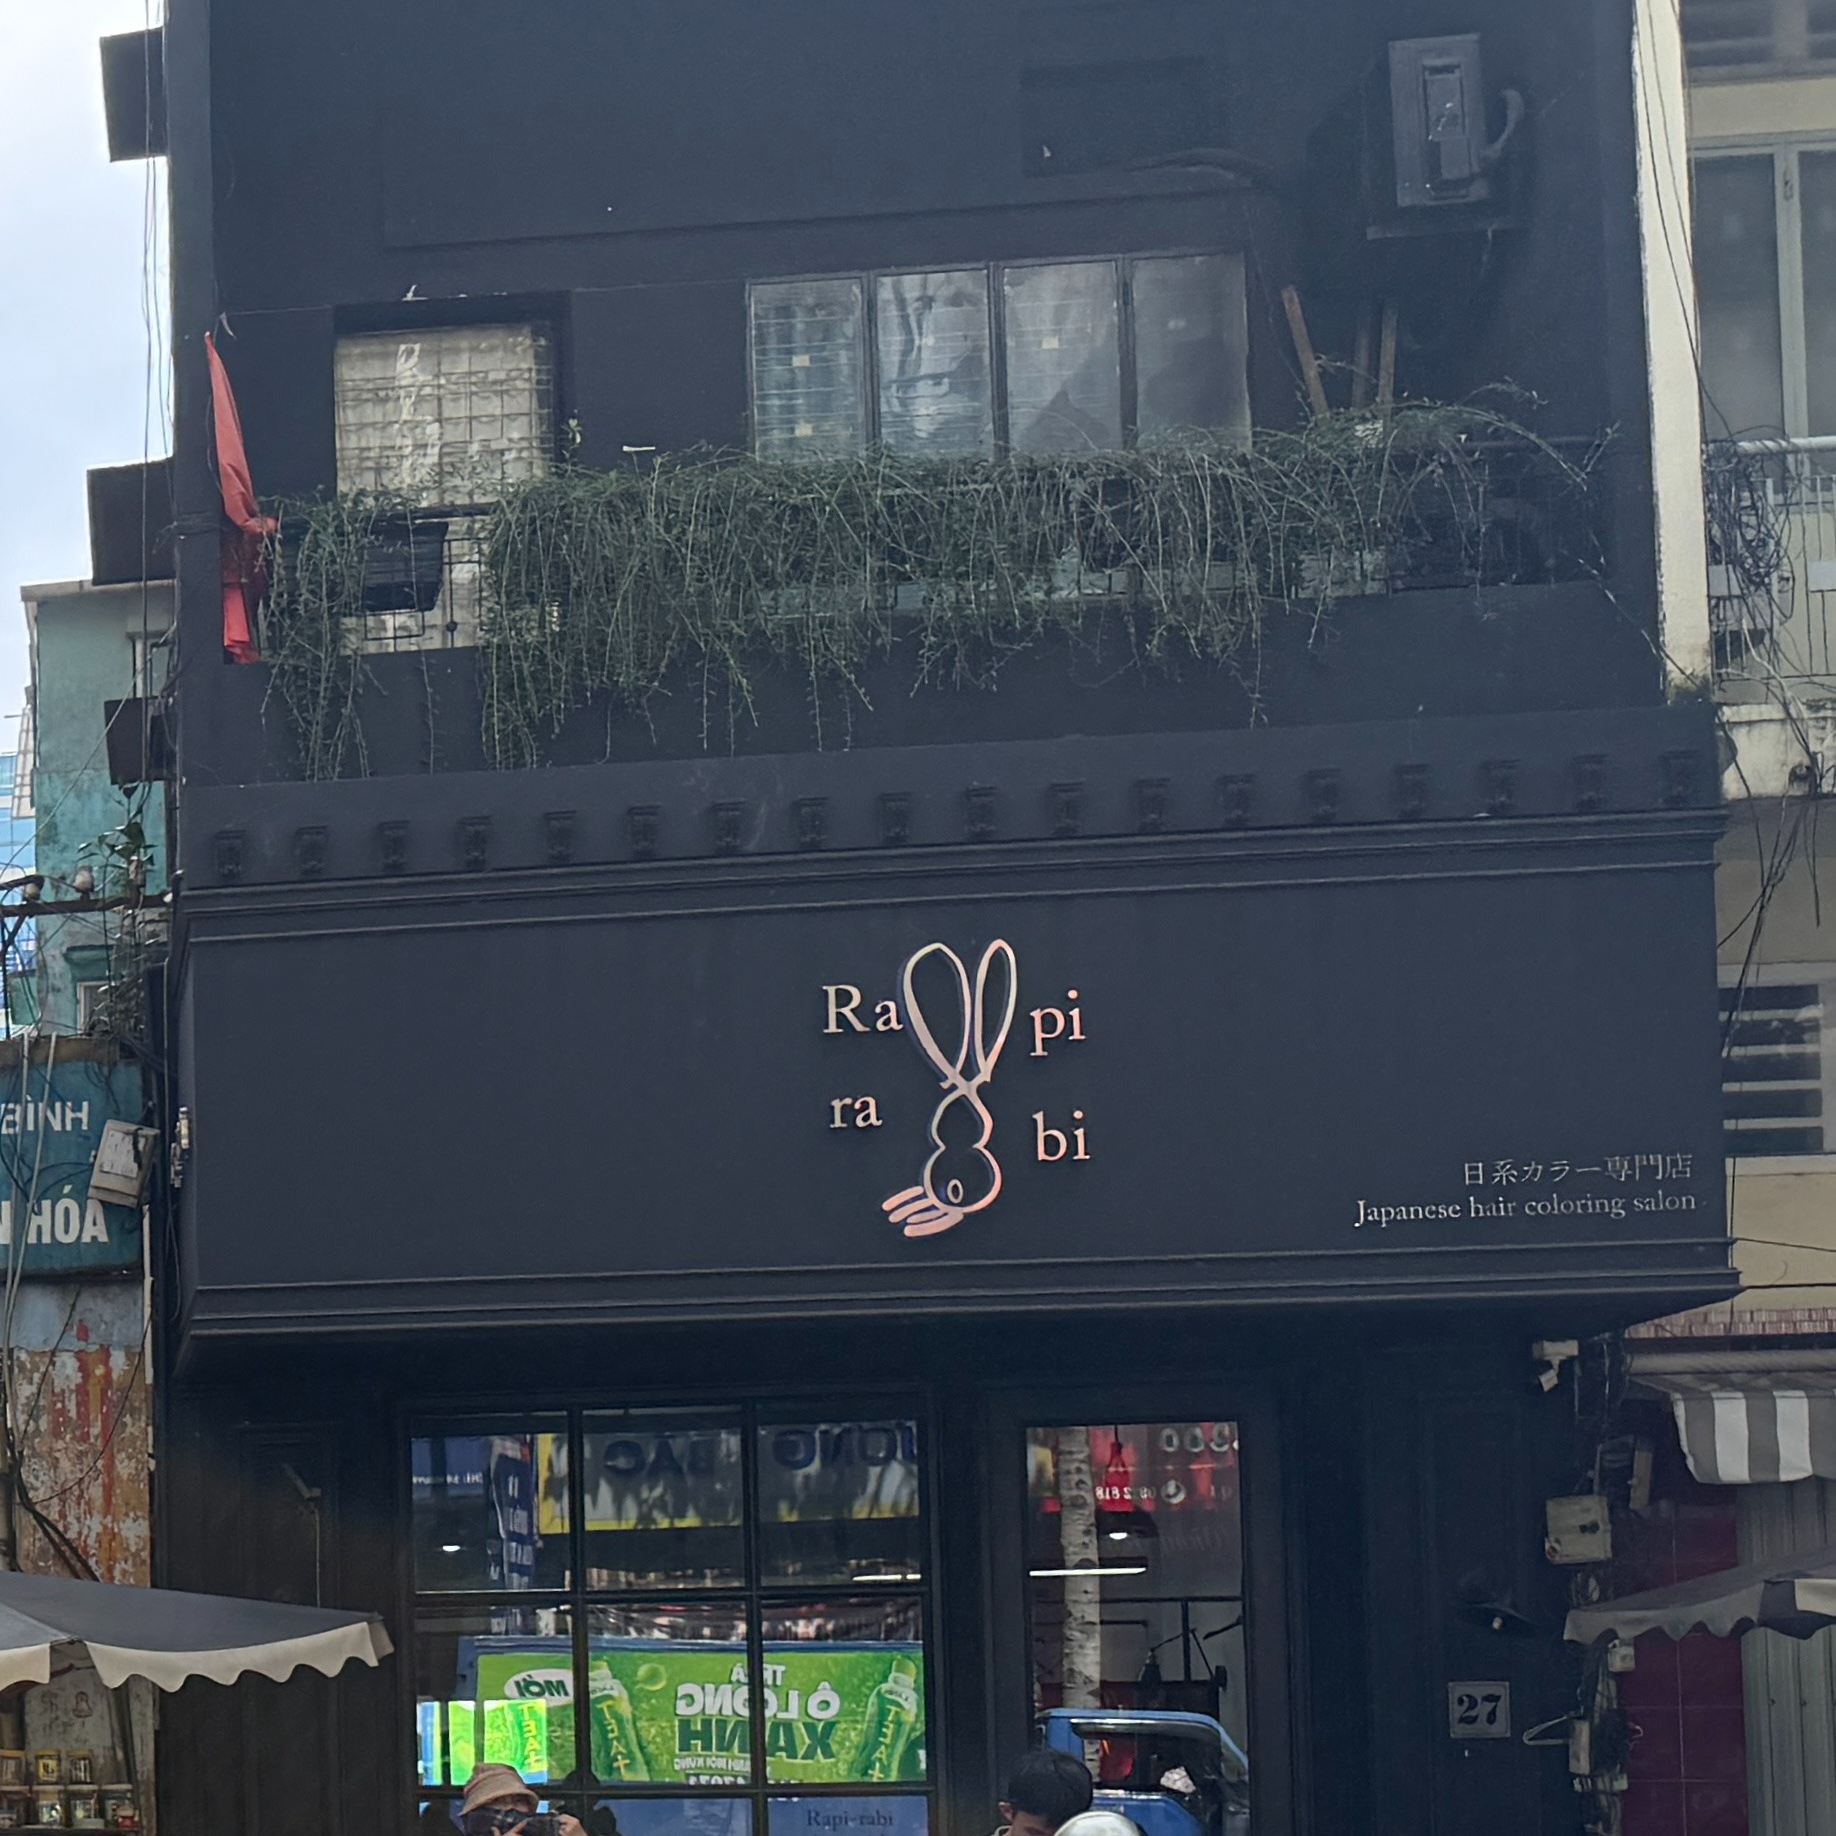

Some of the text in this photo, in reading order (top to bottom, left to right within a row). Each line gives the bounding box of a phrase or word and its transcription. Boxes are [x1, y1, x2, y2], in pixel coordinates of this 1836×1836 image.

[822, 984, 1086, 1057] Ra pi
[0, 1095, 90, 1136] BÌNH
[830, 1095, 1090, 1162] ra bi
[27, 1185, 109, 1244] HÓA
[1354, 1189, 1697, 1230] Japanese hair coloring salon
[1456, 1692, 1502, 1728] 27
